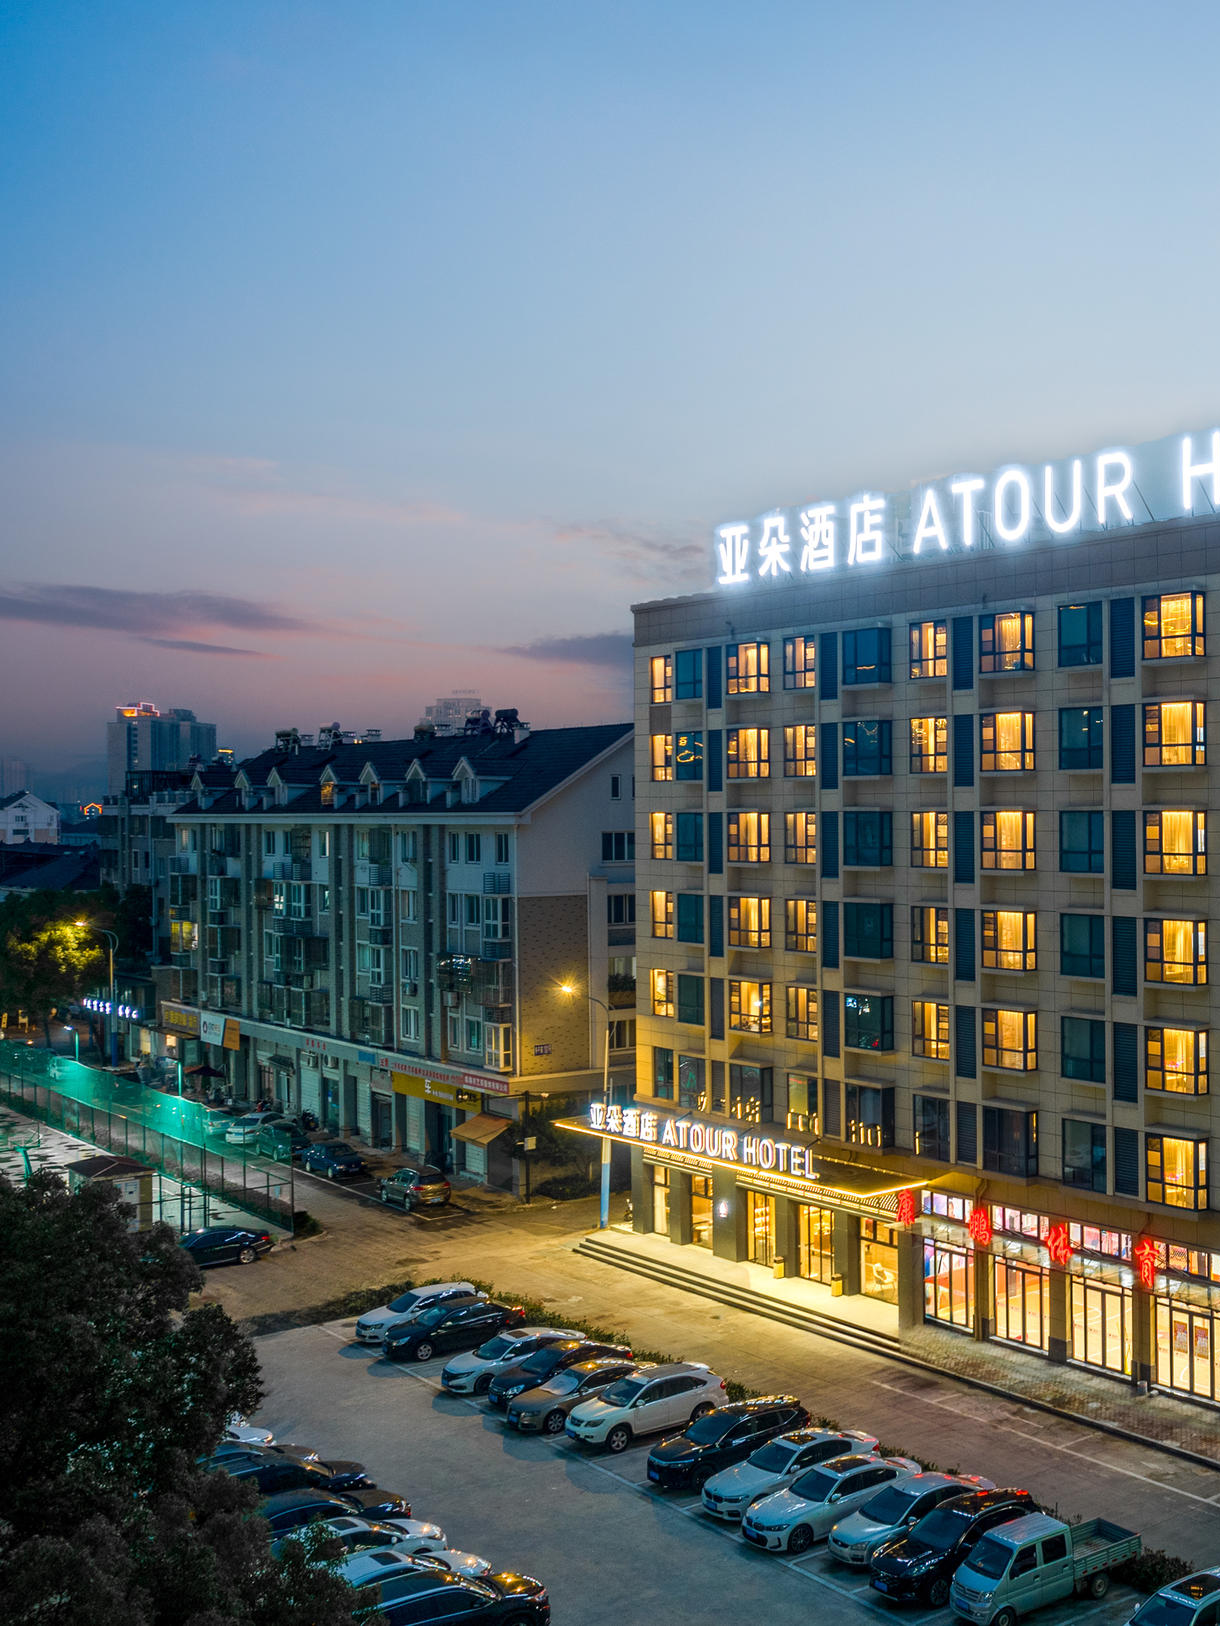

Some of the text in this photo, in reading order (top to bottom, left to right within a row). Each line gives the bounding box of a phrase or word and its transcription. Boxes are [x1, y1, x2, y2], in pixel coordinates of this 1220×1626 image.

[717, 492, 884, 584] 亚朵酒店
[913, 452, 1133, 554] ATOUR
[590, 1103, 657, 1140] 亚朵酒店
[662, 1119, 821, 1180] ATOUR HOTEL
